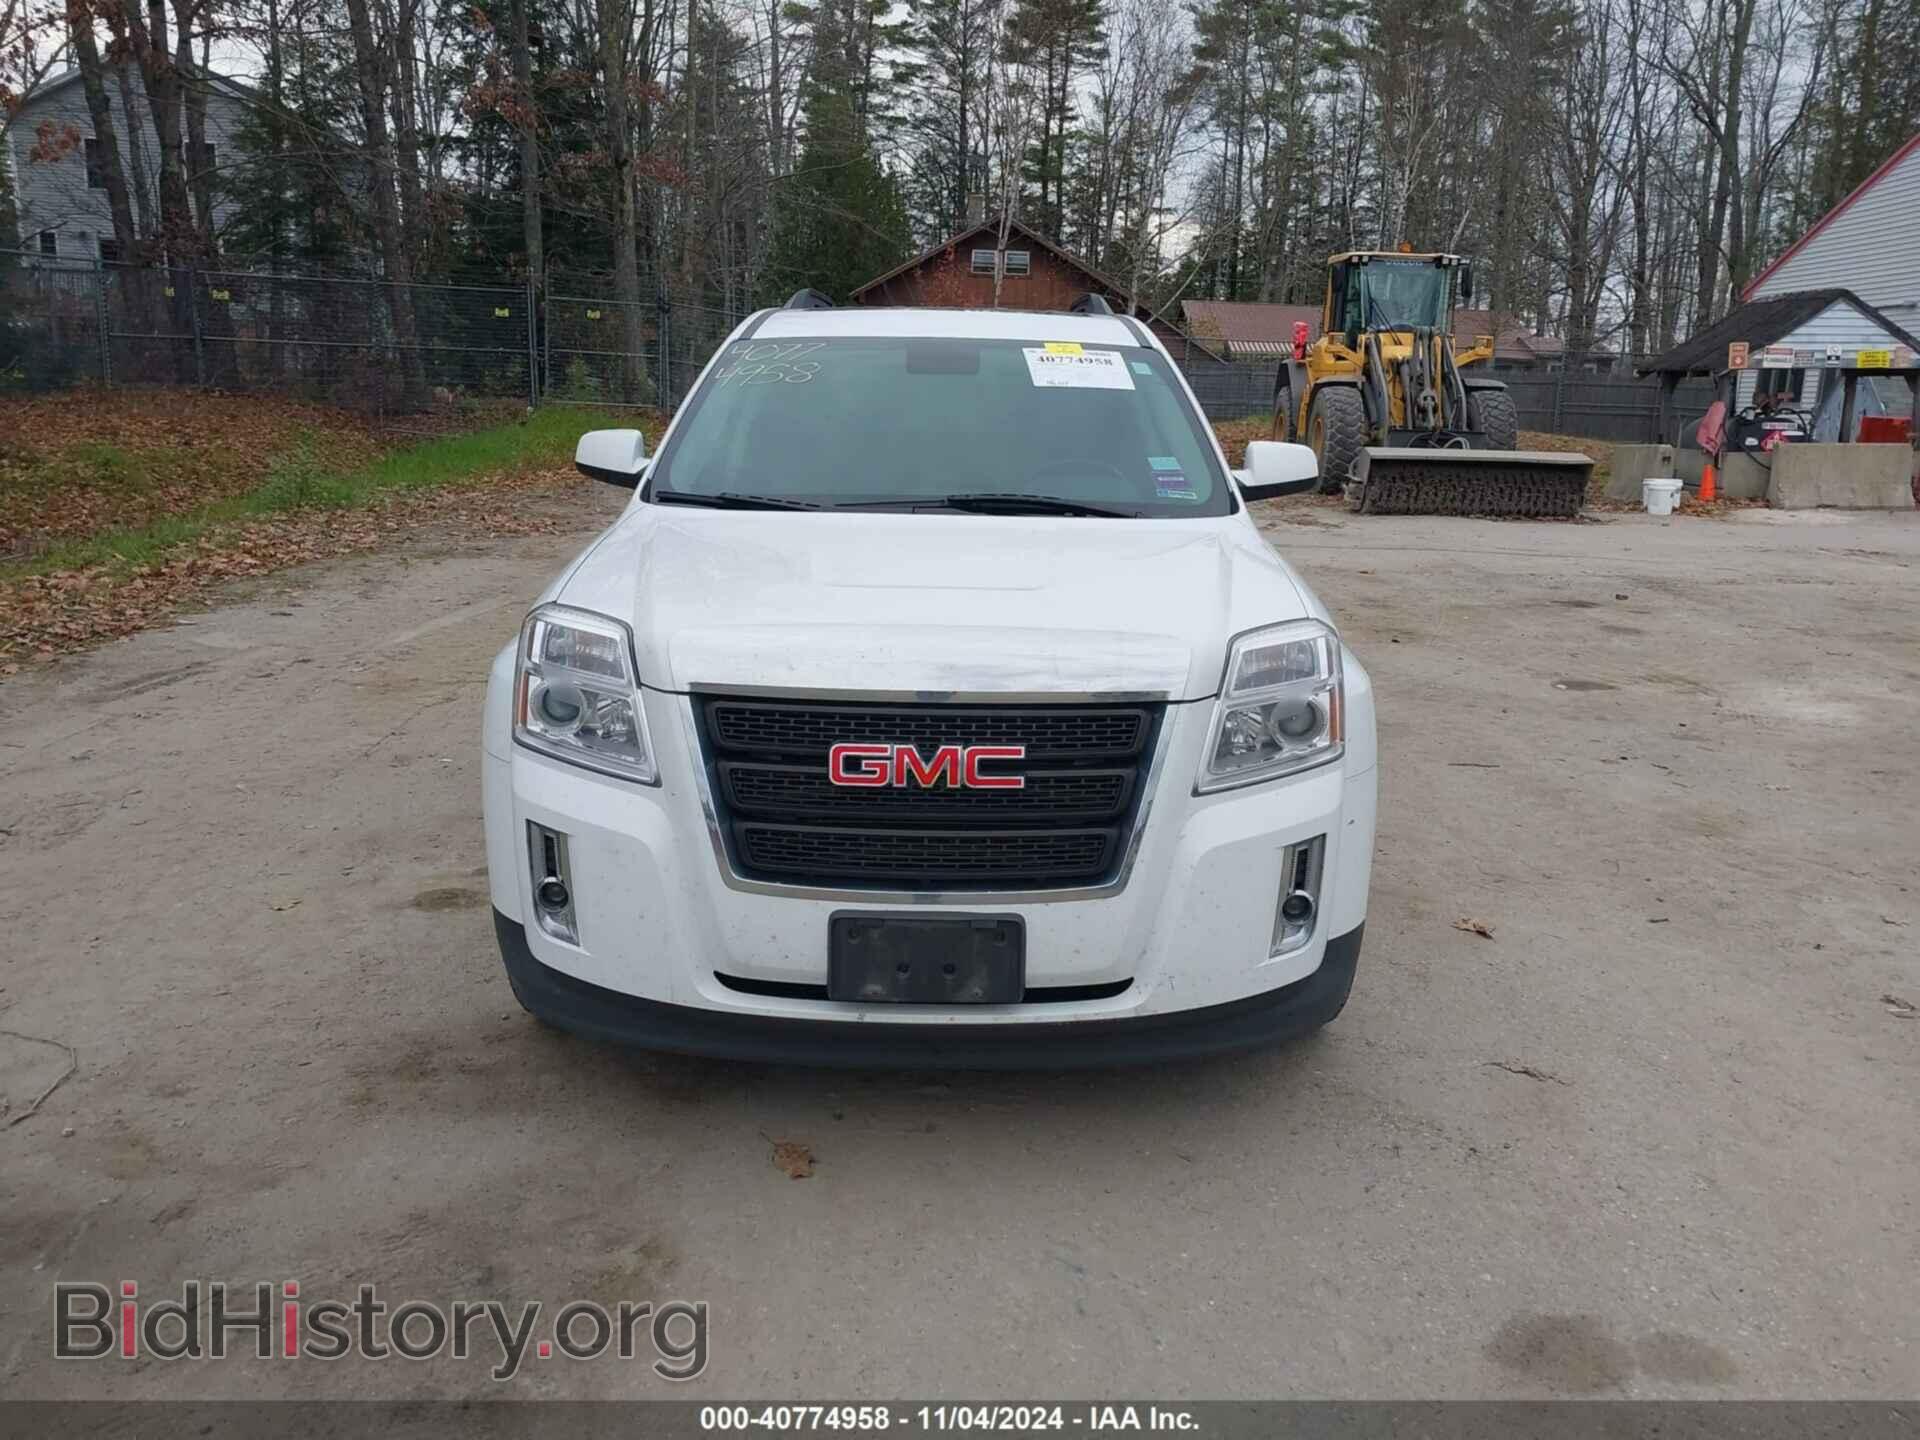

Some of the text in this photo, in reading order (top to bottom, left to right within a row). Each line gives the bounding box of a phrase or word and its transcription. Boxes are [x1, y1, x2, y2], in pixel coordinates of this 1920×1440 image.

[731, 342, 827, 361] 4077
[1037, 355, 1113, 367] 40774958
[715, 360, 821, 387] 4958
[829, 743, 1025, 789] GMC
